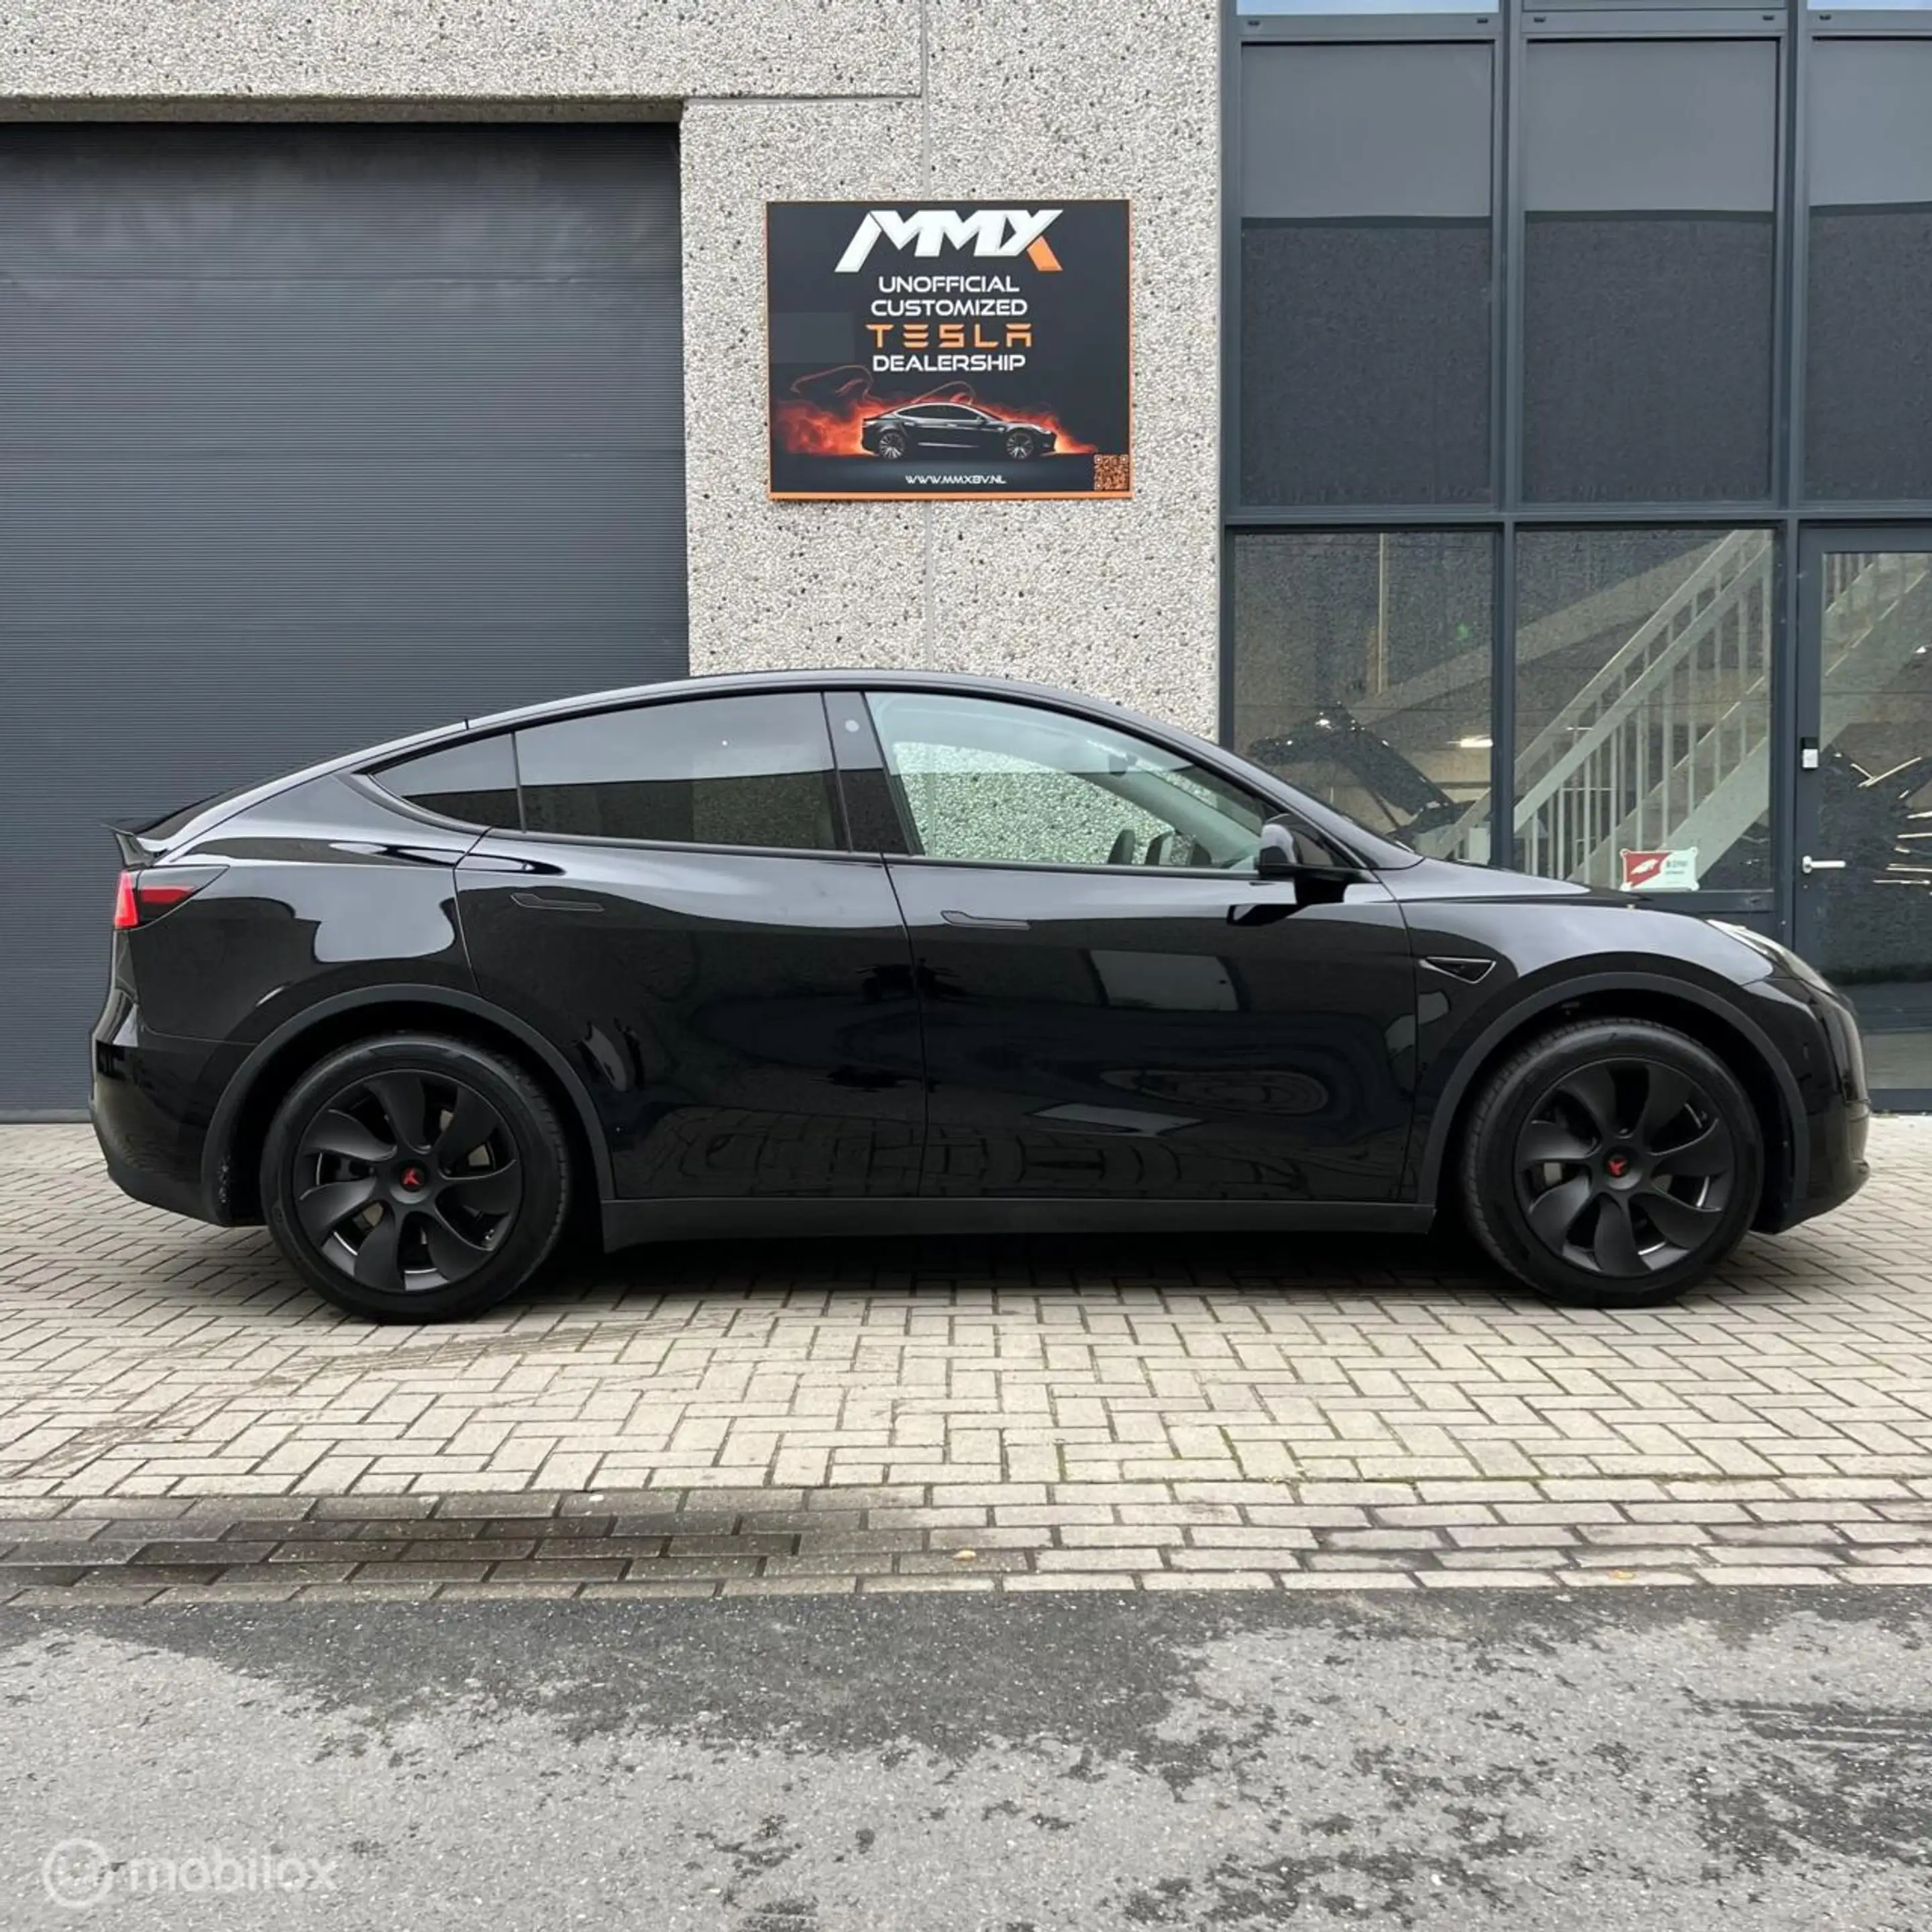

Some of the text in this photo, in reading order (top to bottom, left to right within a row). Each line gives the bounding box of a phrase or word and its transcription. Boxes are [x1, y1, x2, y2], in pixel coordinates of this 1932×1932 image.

[834, 209, 1063, 272] MMX
[878, 276, 1020, 293] UNOFFICIAL
[871, 299, 1028, 317] CUSTOMIZED
[865, 323, 1032, 348] TESLA
[872, 354, 1026, 372] DEALERSHIP
